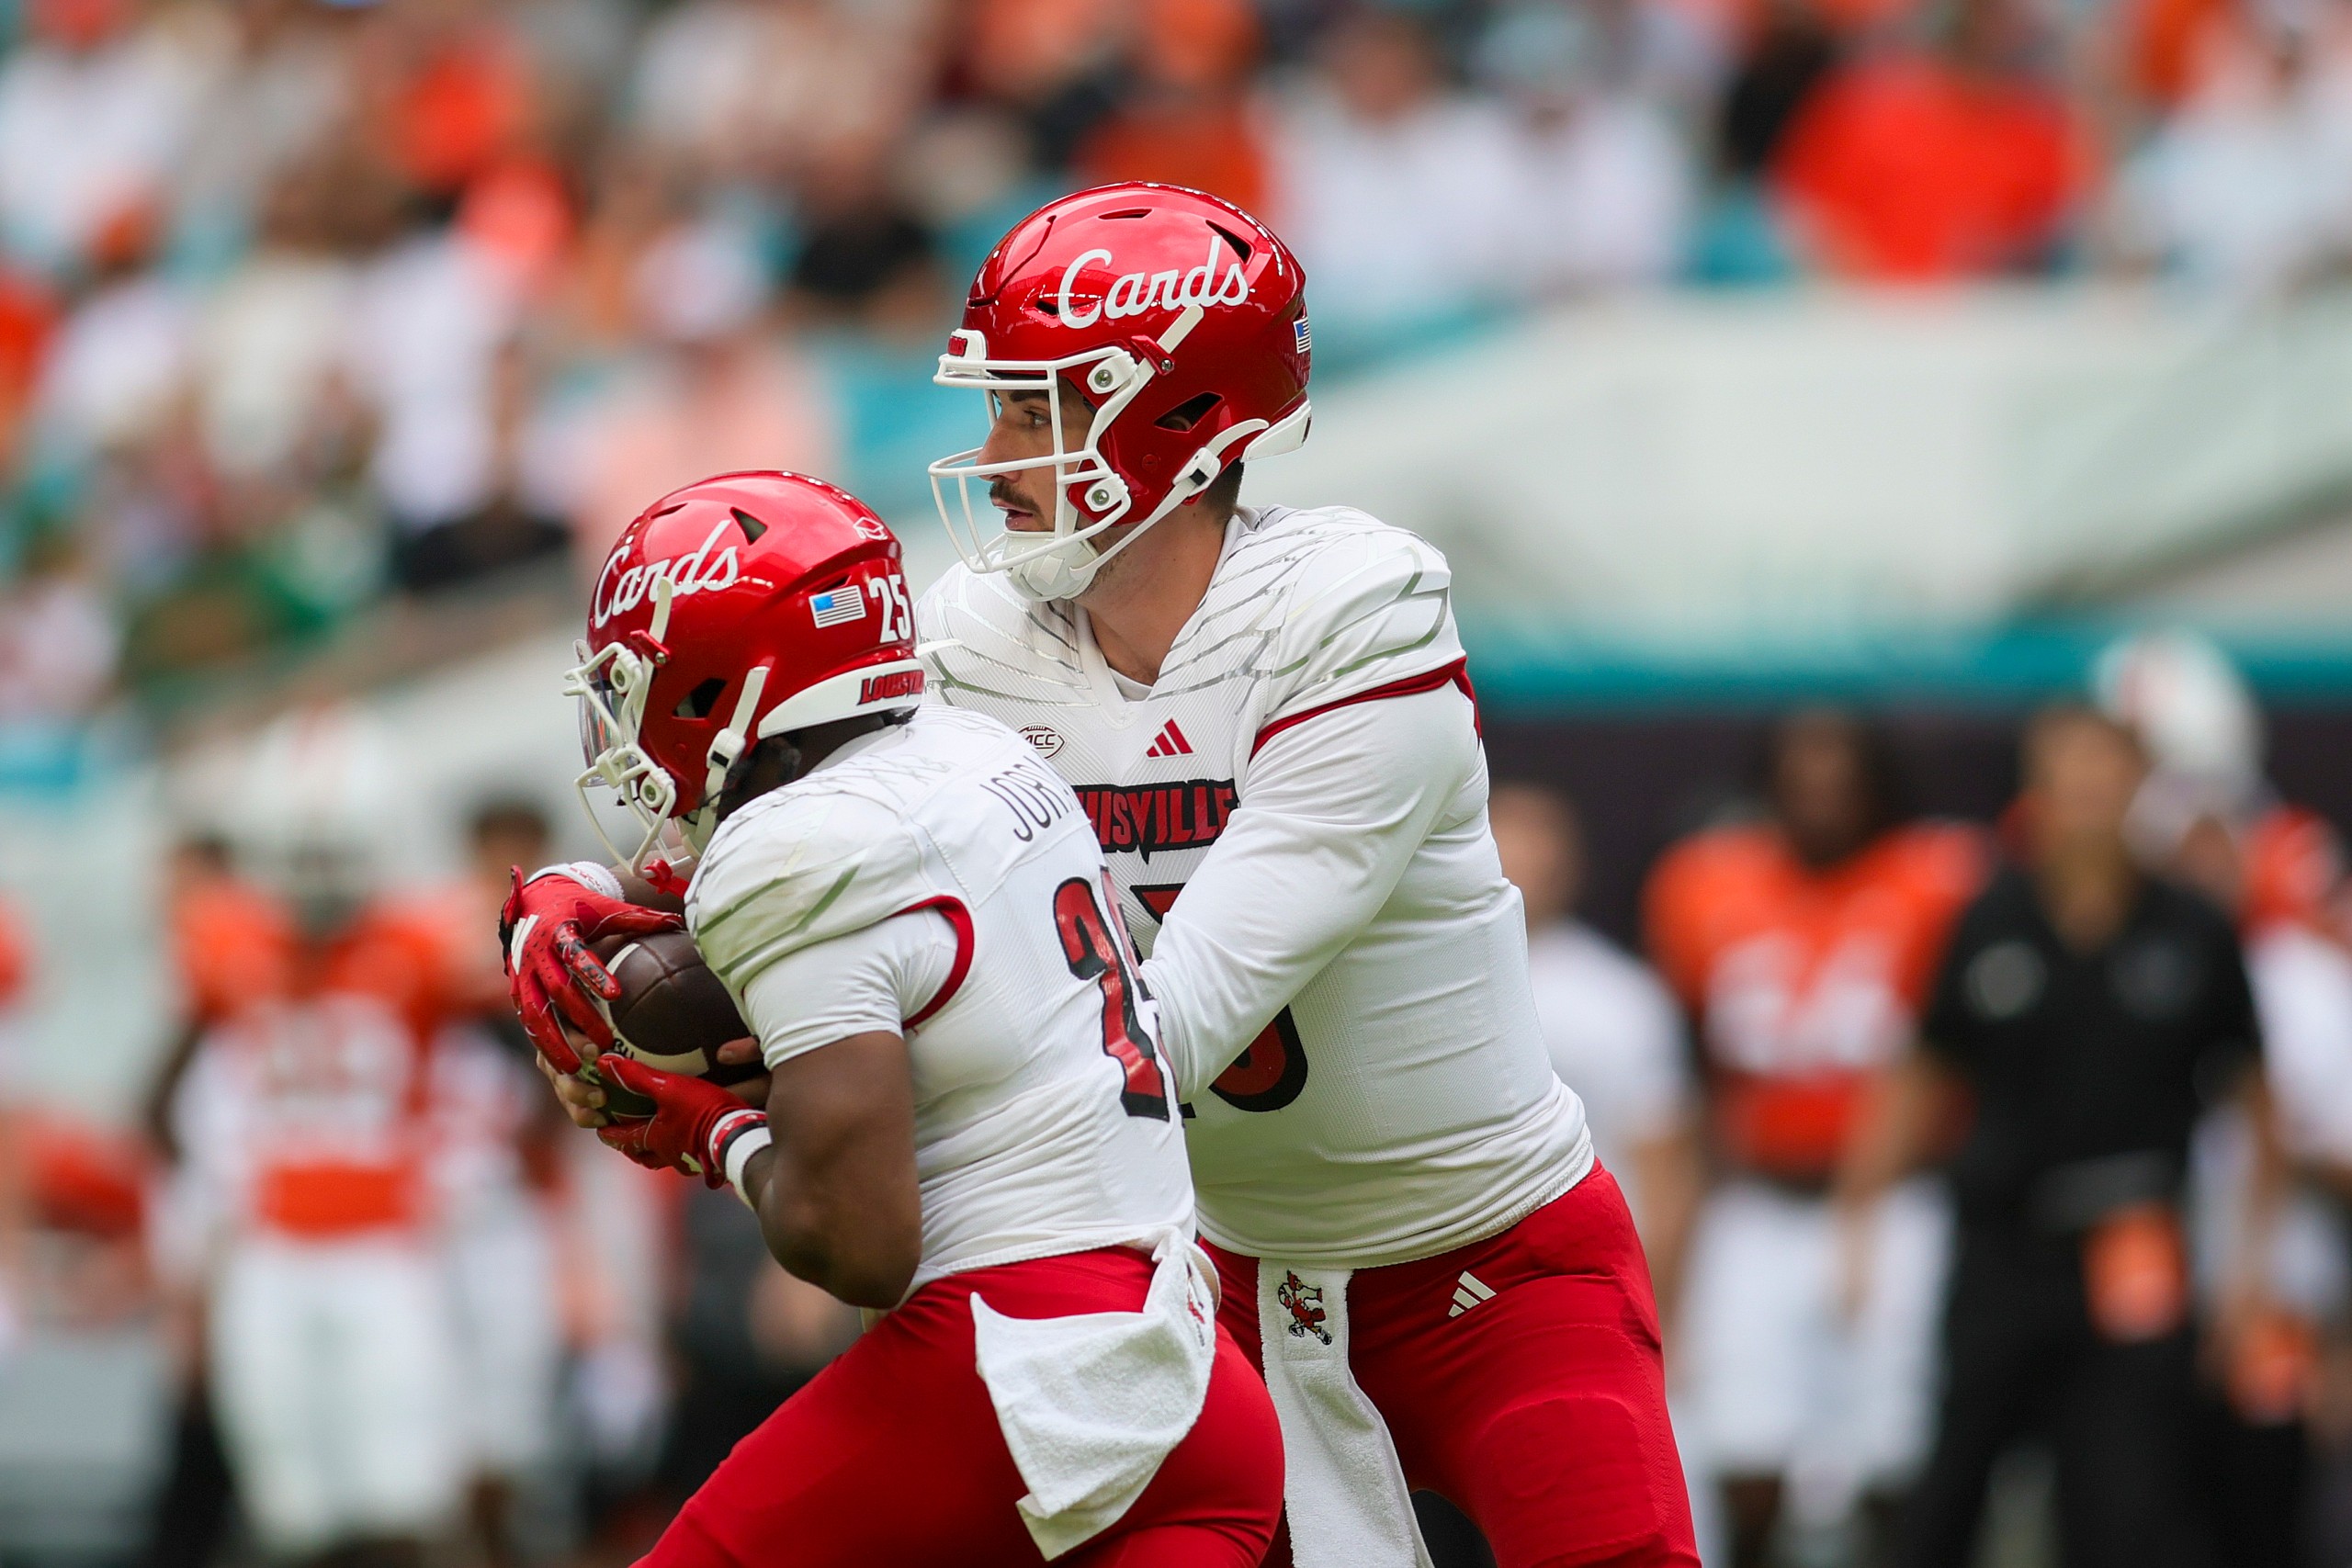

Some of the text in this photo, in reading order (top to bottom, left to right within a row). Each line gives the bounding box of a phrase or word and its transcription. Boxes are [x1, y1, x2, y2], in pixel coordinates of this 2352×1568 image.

[1057, 235, 1250, 329] Cards
[594, 519, 739, 629] Cards
[868, 574, 911, 643] 25
[1053, 865, 1185, 1130] 2
